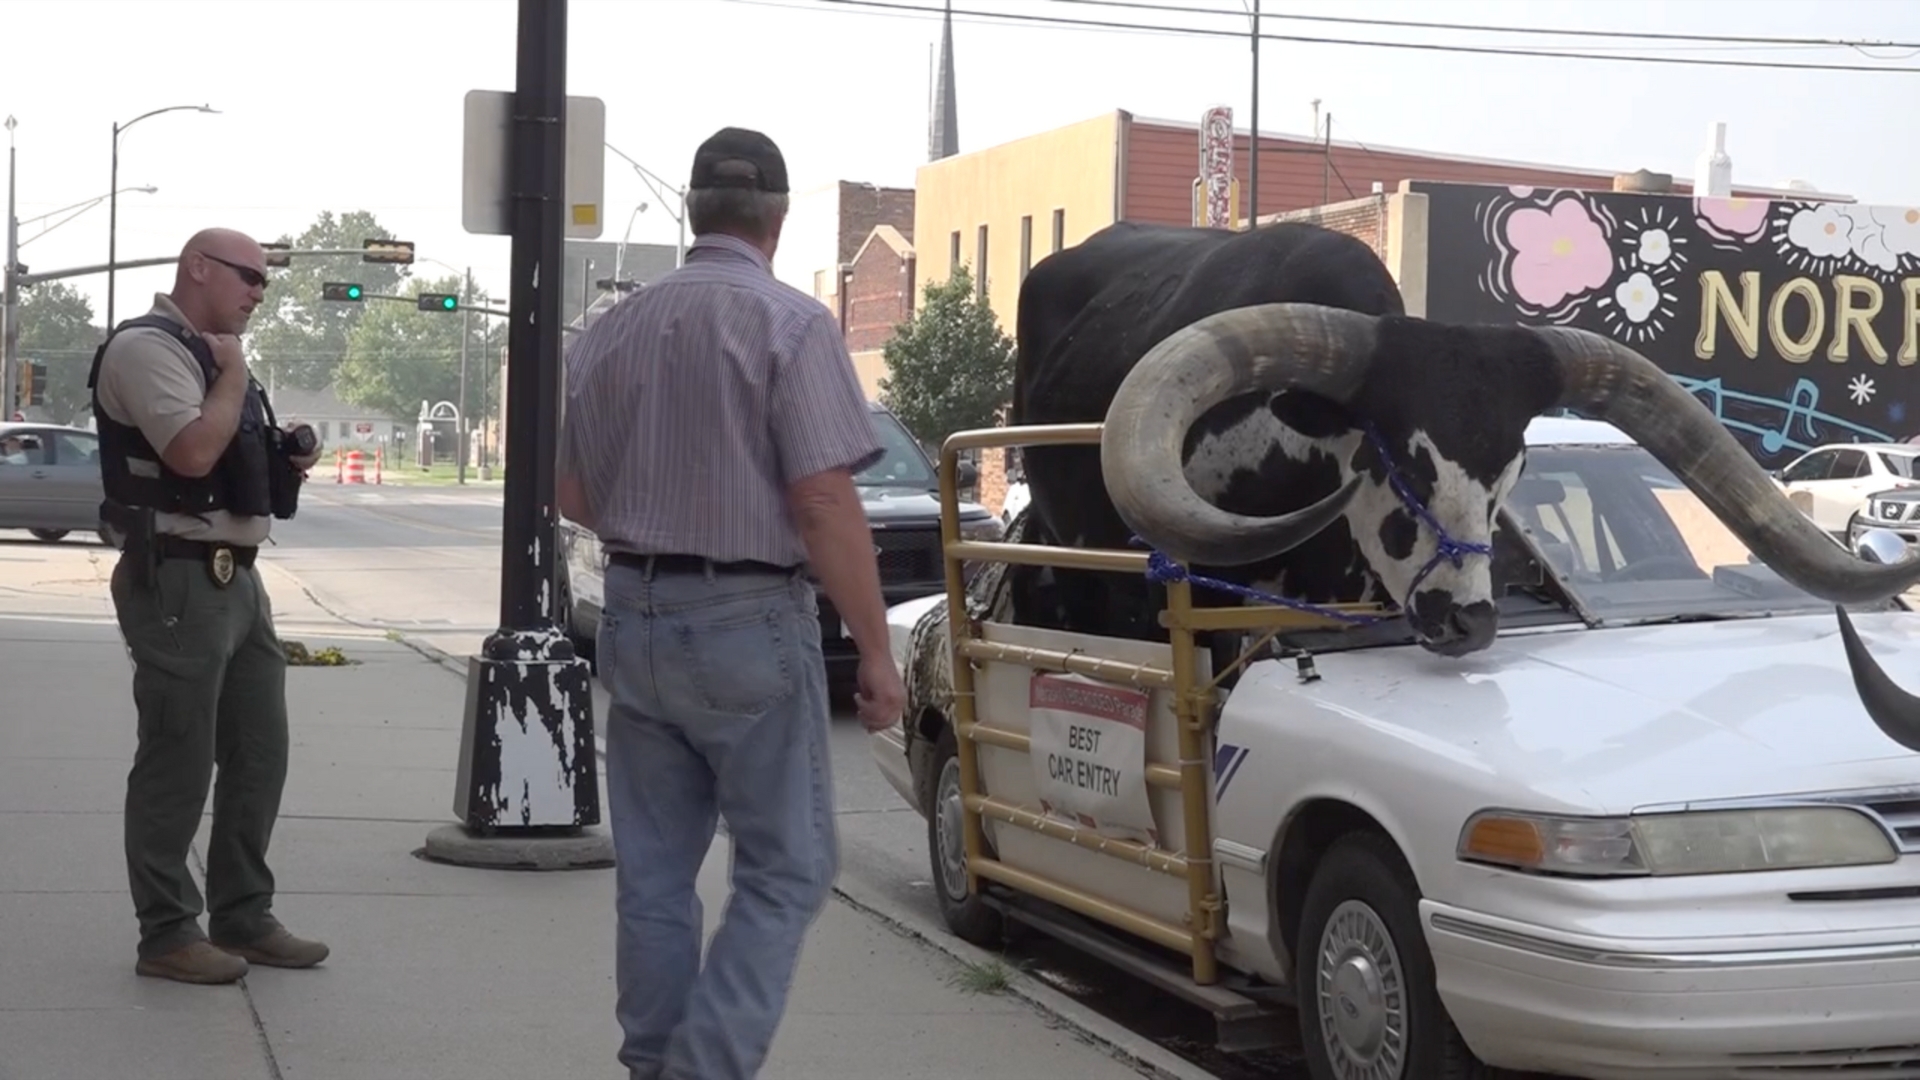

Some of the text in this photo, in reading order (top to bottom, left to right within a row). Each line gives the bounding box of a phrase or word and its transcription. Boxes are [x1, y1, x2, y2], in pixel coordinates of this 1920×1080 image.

[1069, 725, 1102, 753] BEST
[1048, 753, 1121, 797] CAR ENTRY
